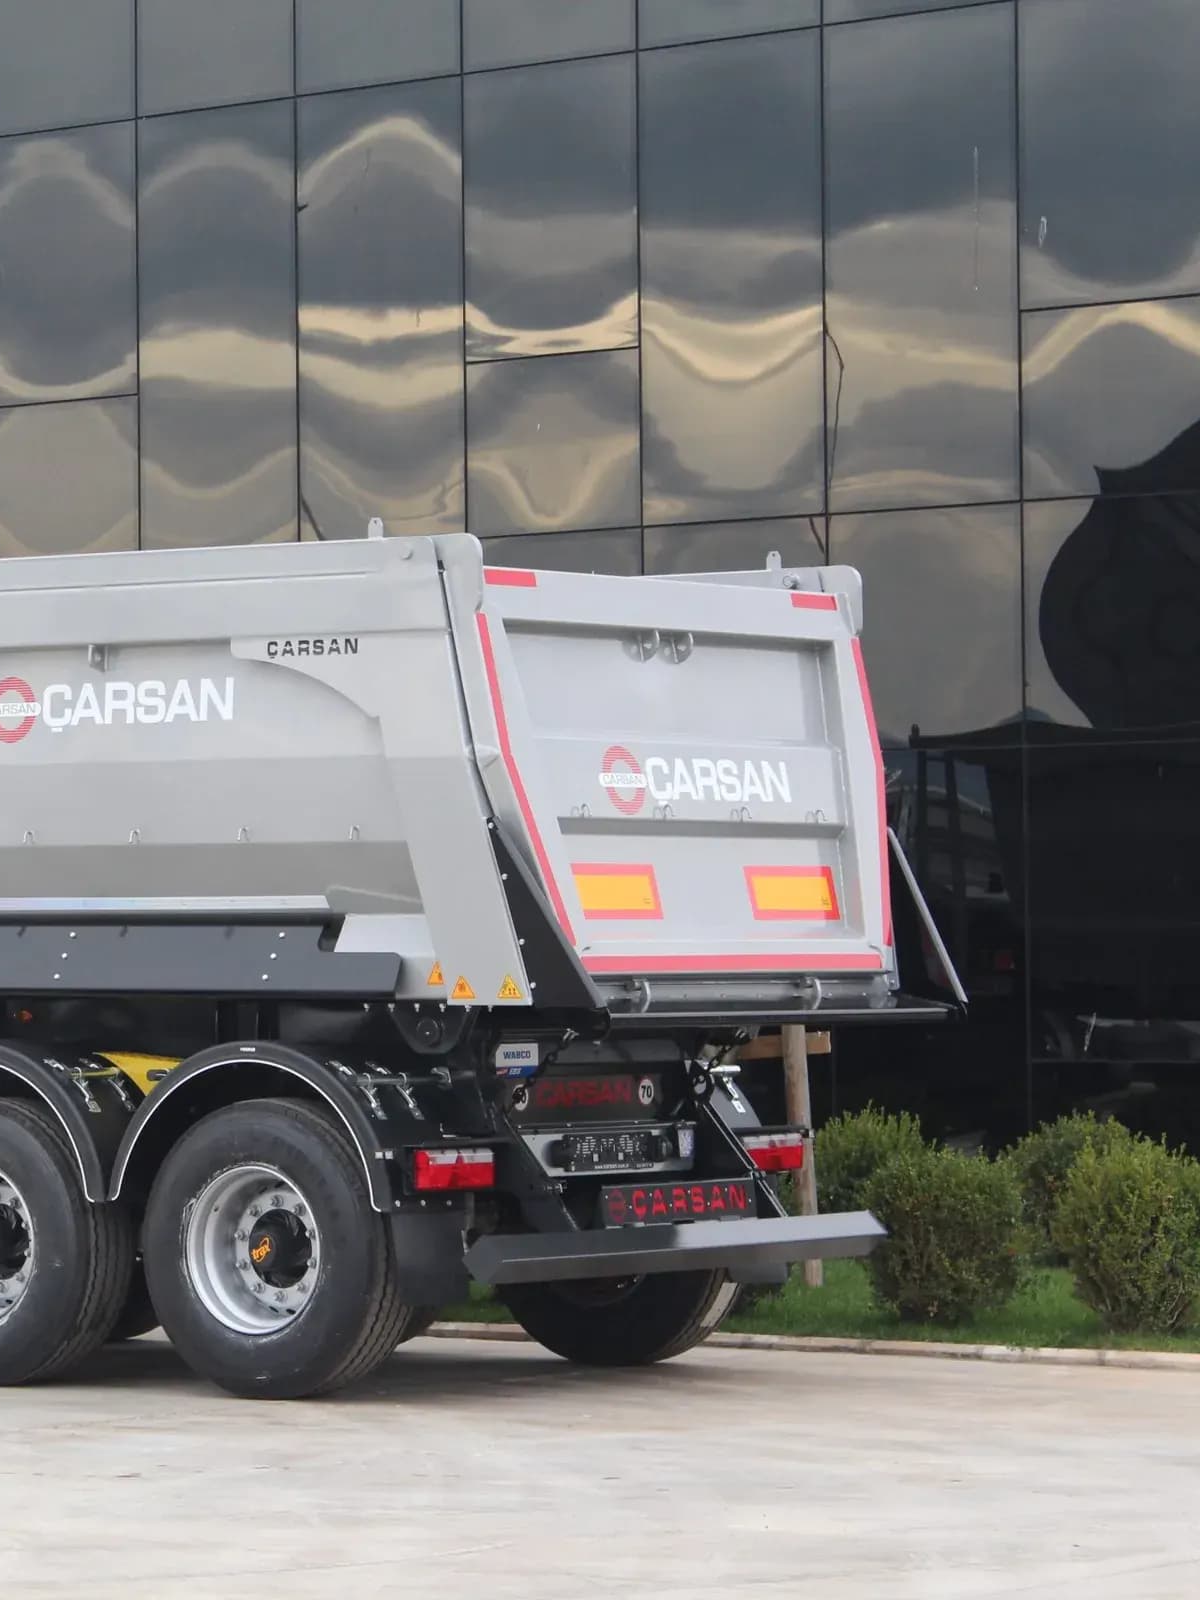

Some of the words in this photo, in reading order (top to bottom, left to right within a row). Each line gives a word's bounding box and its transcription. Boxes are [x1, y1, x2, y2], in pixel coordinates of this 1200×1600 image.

[267, 638, 358, 659] ÇARSAN
[42, 677, 234, 732] ÇARSAN
[645, 757, 792, 805] ÇARSAN
[503, 1051, 531, 1060] WABCO
[641, 1085, 653, 1098] 70
